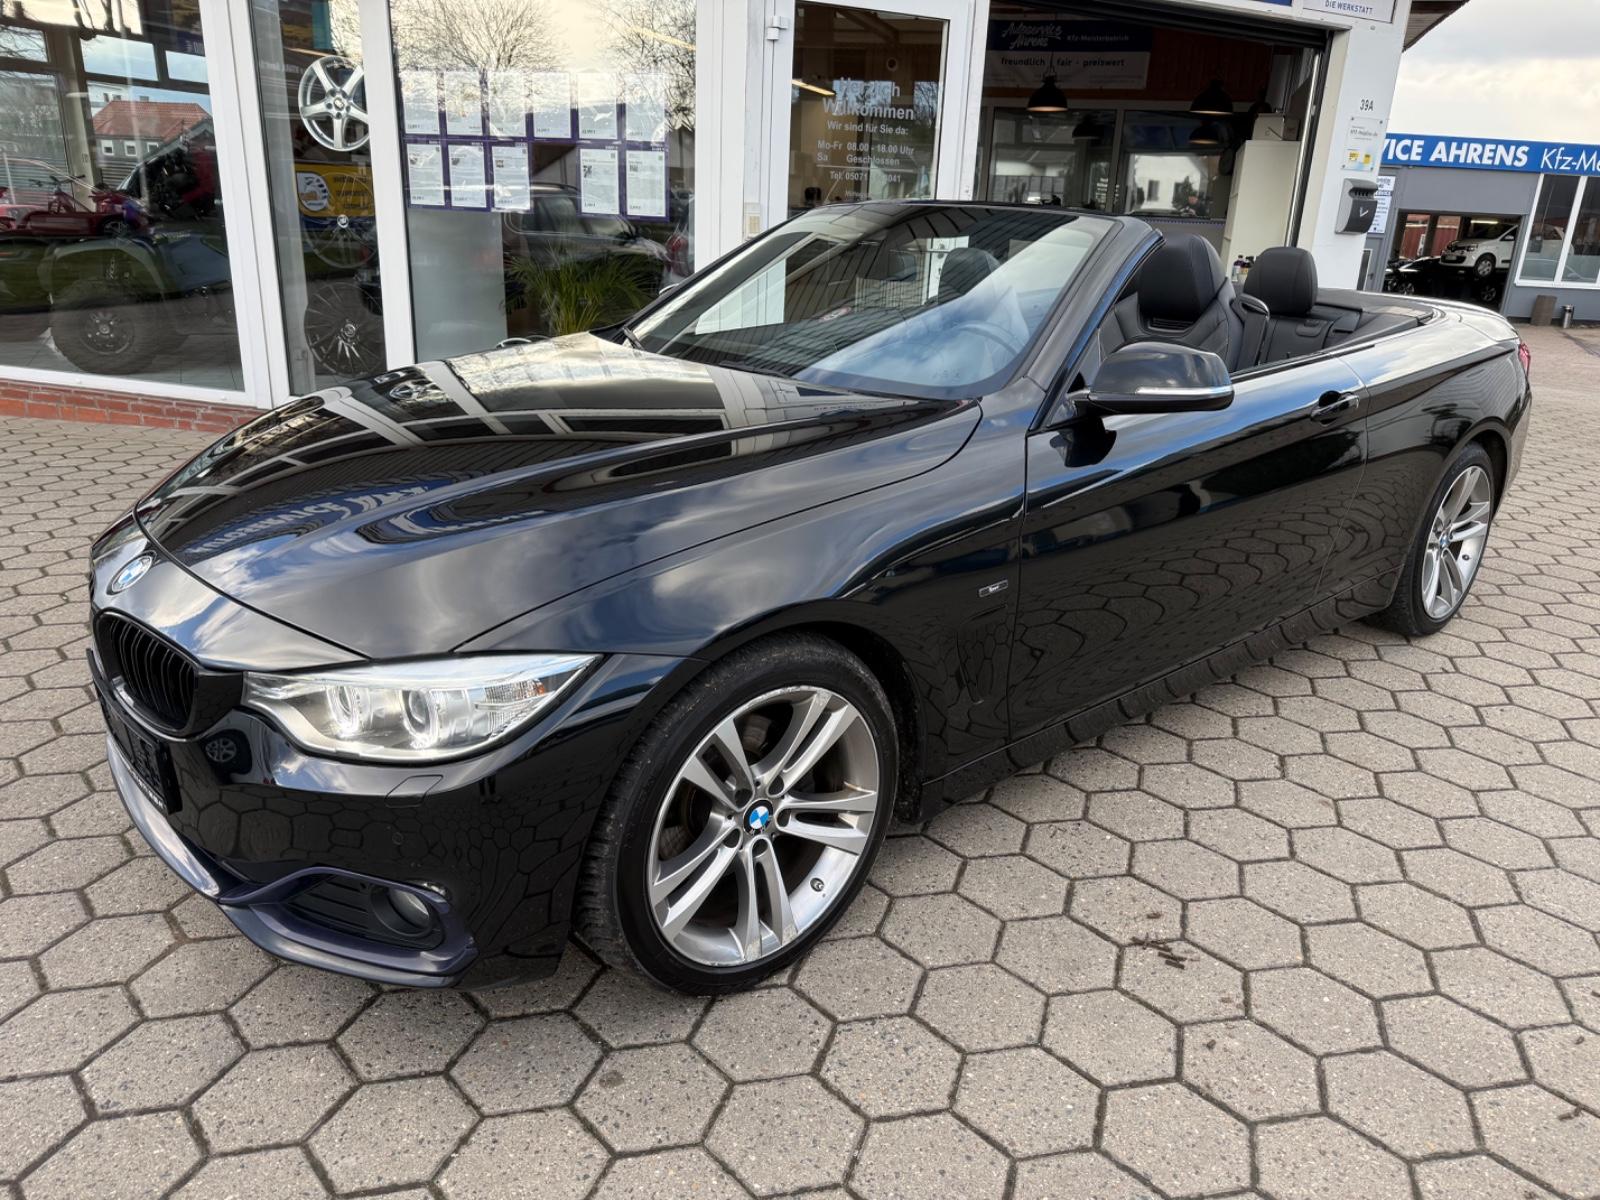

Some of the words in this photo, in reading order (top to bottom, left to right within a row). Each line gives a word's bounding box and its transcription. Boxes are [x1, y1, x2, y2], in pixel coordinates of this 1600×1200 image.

[1325, 0, 1336, 8] DIE
[1337, 1, 1374, 14] WERKSTATT
[1001, 57, 1046, 66] freundlich
[1056, 57, 1073, 66] fair
[1082, 58, 1125, 68] preiswert
[1360, 98, 1374, 111] 39A
[827, 120, 842, 130] Wir
[844, 121, 864, 132] sind
[879, 123, 894, 134] Sie
[895, 125, 909, 136] da:
[817, 139, 843, 150] Mo-Fr
[817, 153, 828, 161] Sa
[846, 154, 900, 166] Geschlossen
[1429, 141, 1530, 167] AHRENS
